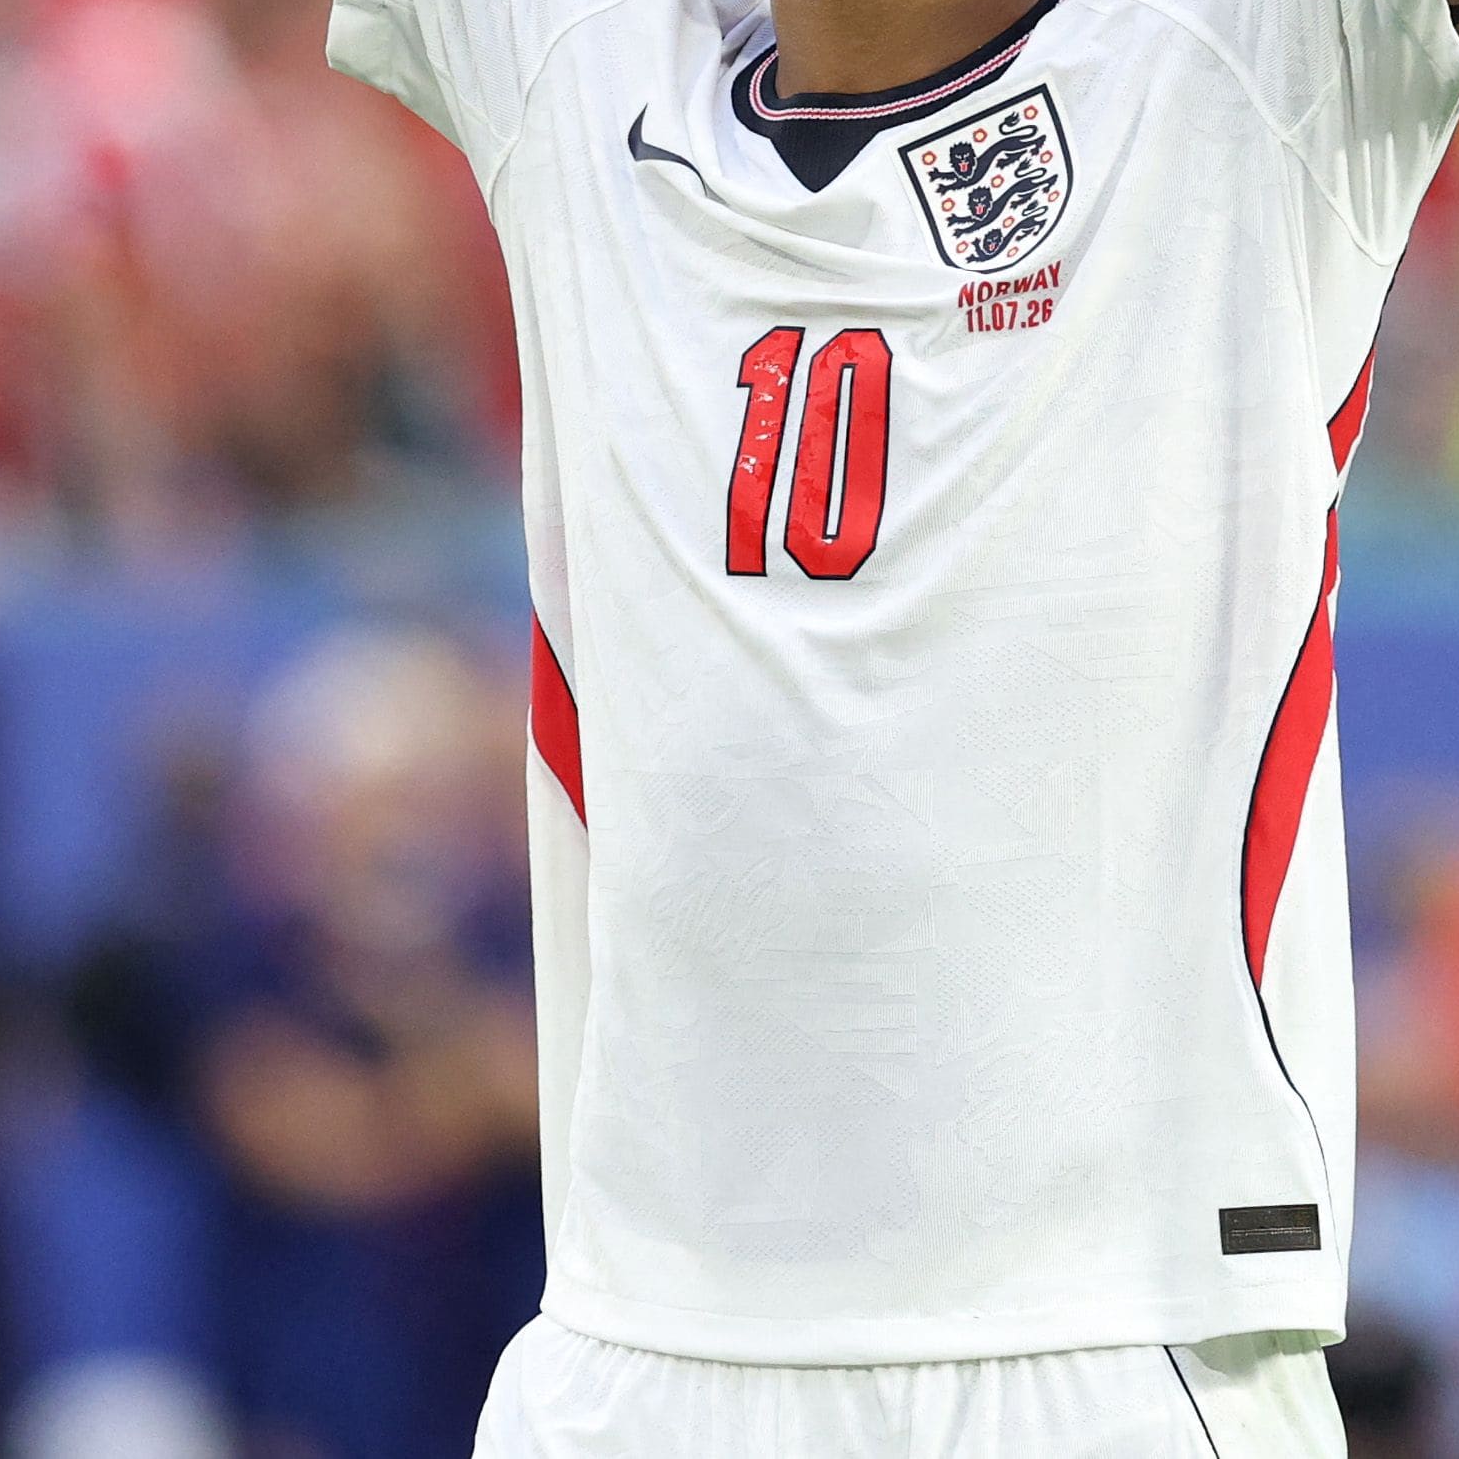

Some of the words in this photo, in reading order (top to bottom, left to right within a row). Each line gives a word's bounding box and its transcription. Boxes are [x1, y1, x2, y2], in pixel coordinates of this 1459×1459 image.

[958, 260, 1062, 308] NORWAY
[966, 298, 1053, 333] 11.07.26
[726, 326, 893, 580] 10
